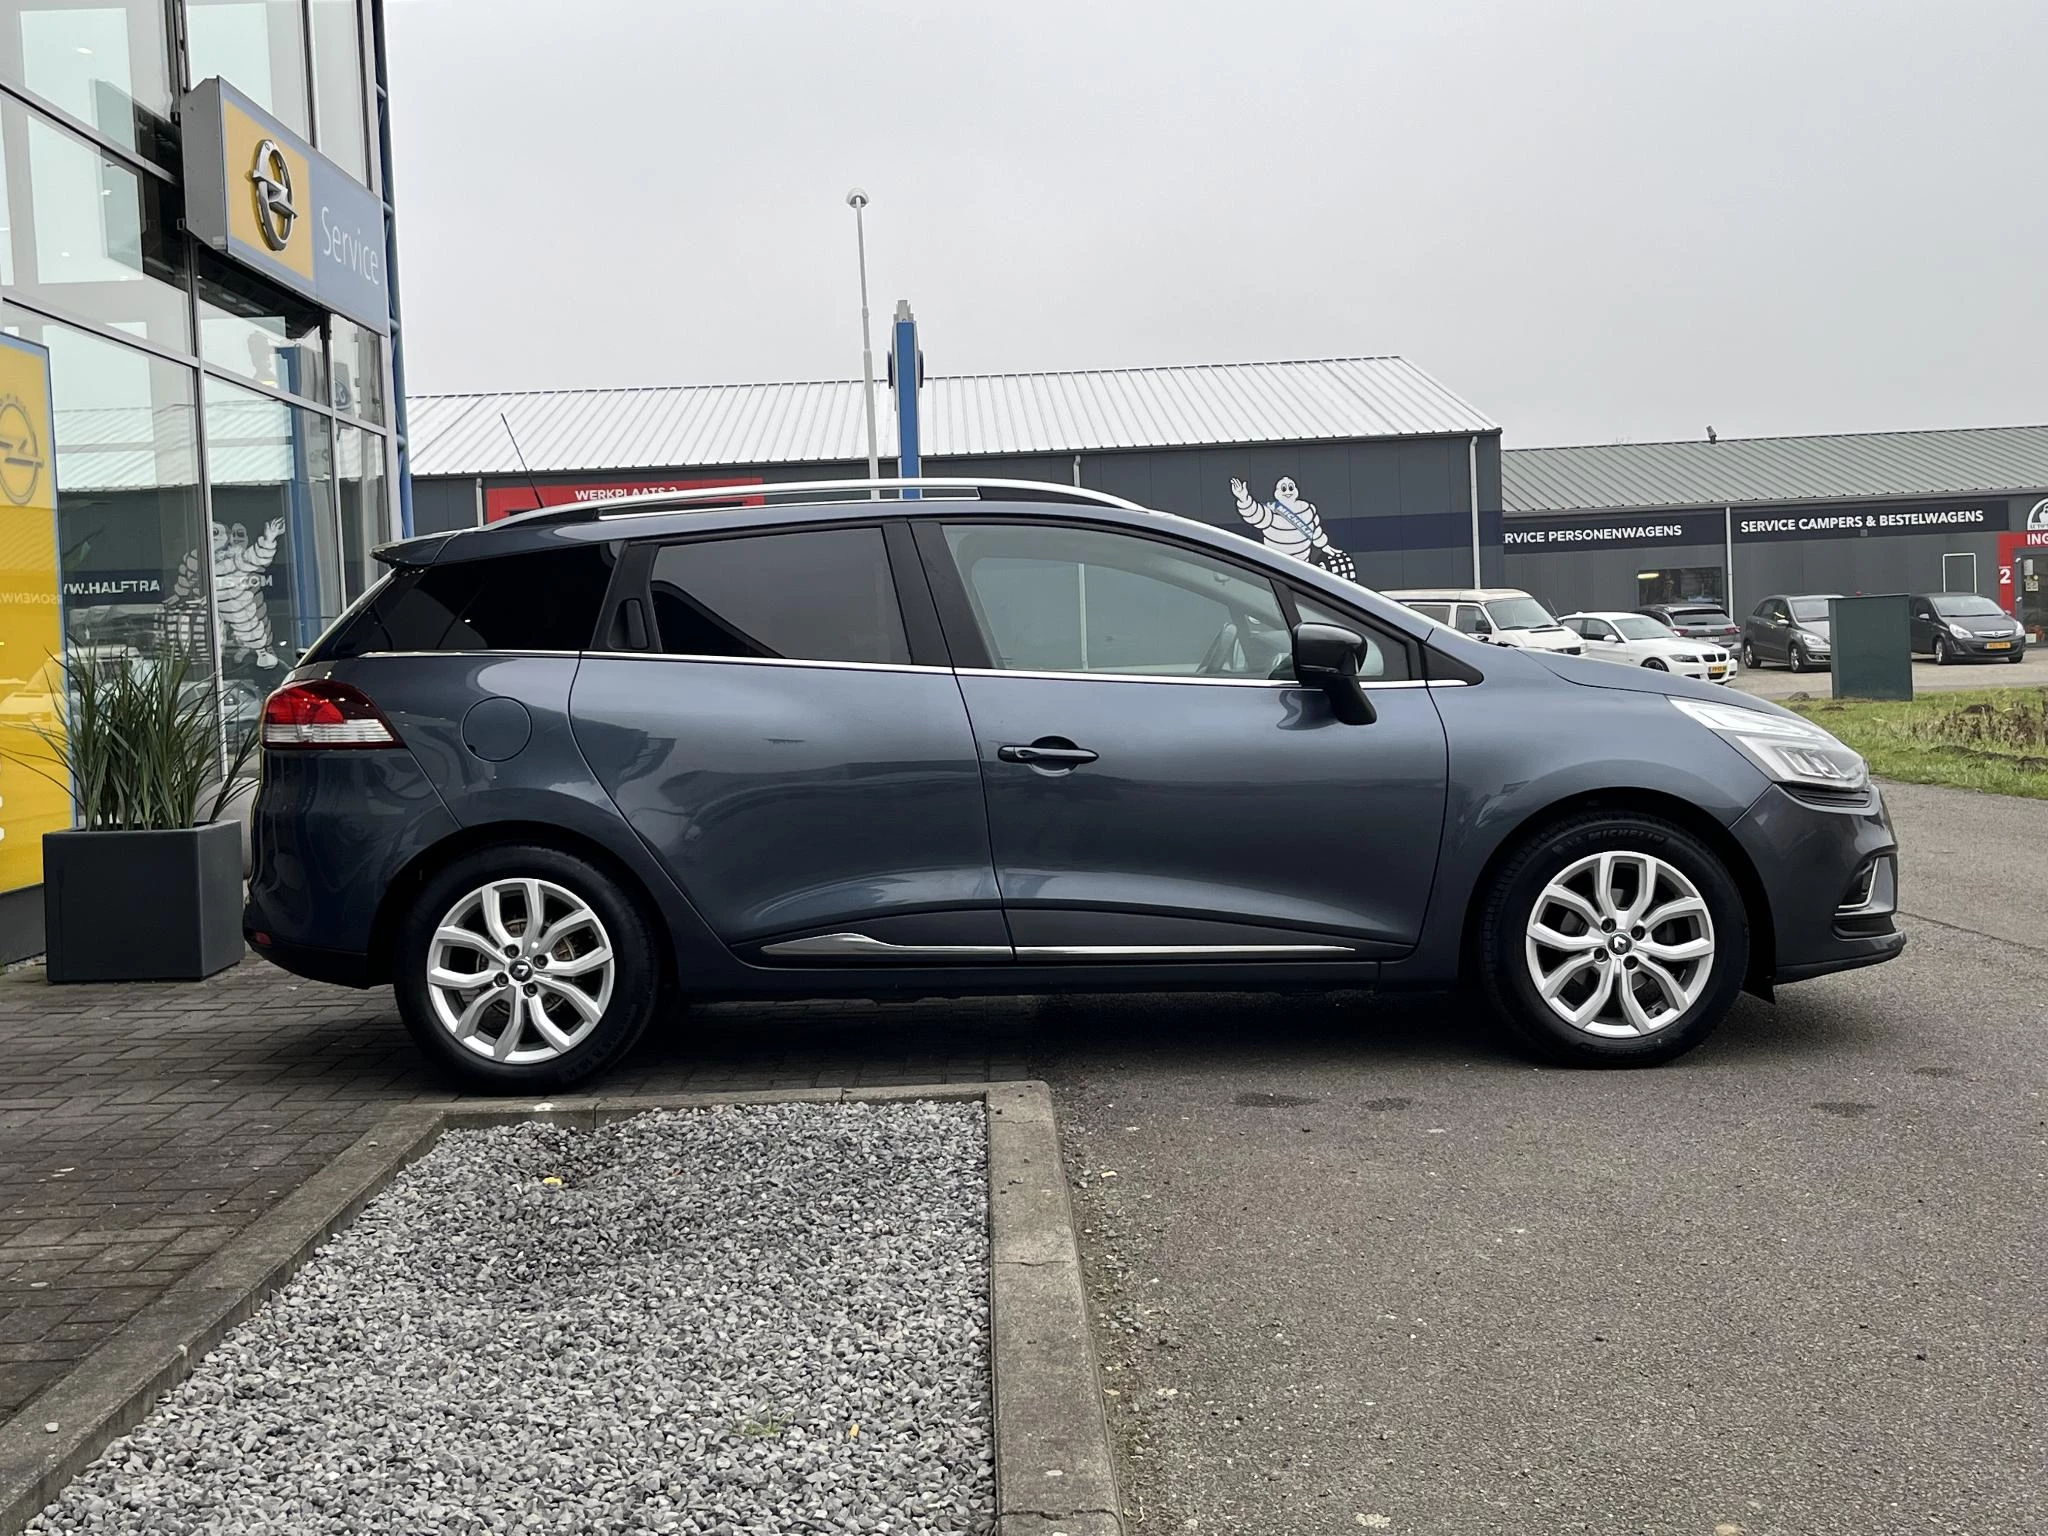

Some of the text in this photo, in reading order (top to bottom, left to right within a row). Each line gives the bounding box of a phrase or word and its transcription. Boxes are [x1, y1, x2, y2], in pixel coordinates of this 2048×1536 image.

[321, 206, 379, 285] Service
[1740, 510, 1984, 533] SERVICE CAMPERS & BESTELWAGENS
[1503, 524, 1682, 544] RVICE PERSONENWAGENS
[2000, 567, 2011, 584] 2
